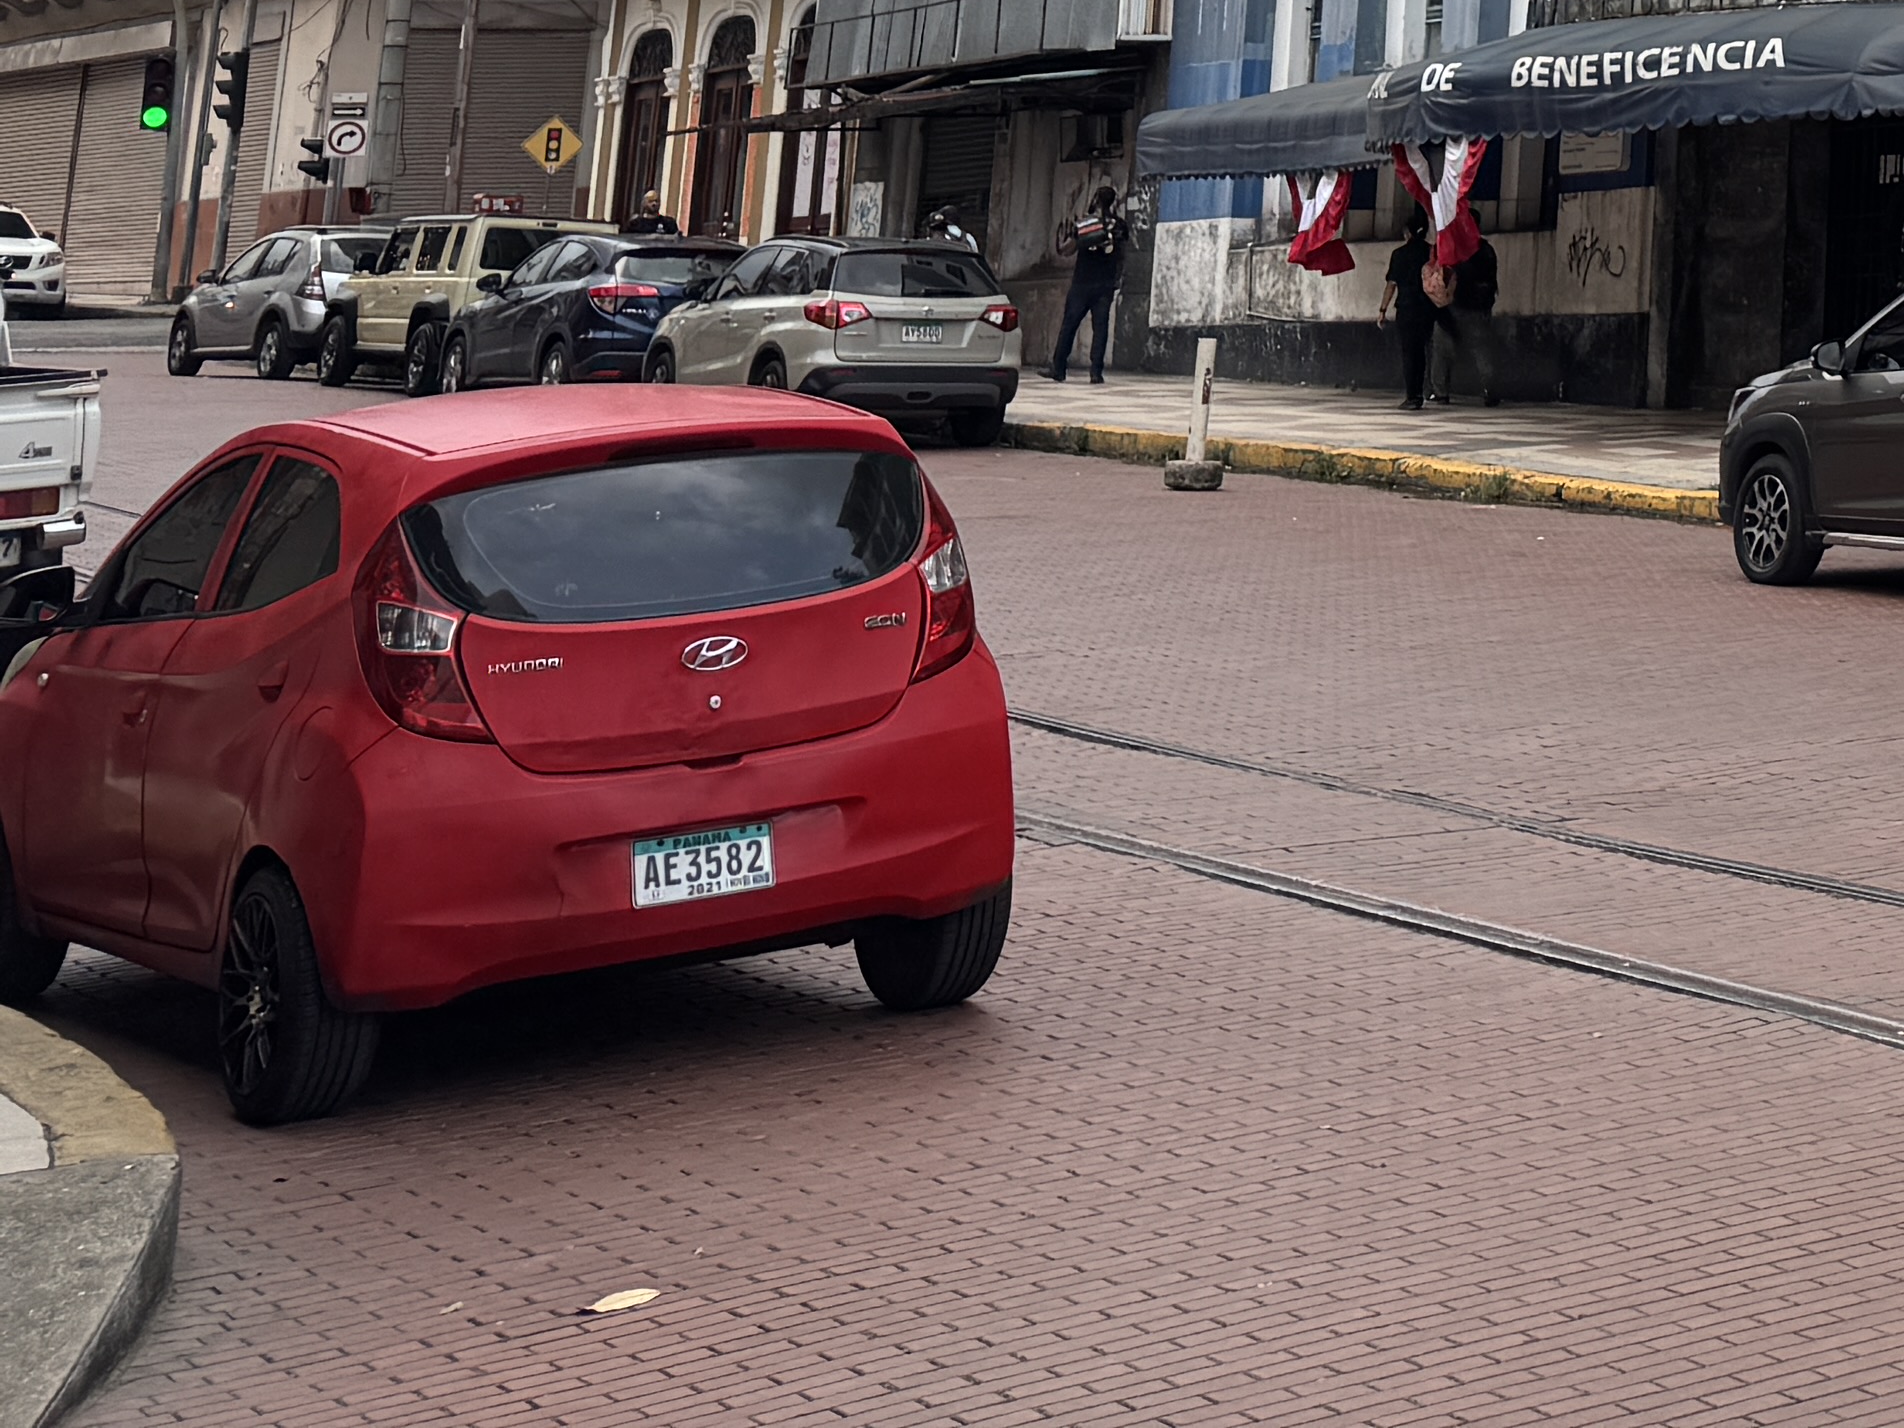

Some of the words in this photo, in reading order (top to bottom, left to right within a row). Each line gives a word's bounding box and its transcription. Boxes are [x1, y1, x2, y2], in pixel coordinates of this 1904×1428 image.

[1420, 62, 1462, 92] DE
[1510, 37, 1787, 88] BENEFICENCIA
[488, 657, 564, 675] HYUNDAI
[673, 831, 732, 849] PANAMA
[644, 840, 764, 890] AE3582
[687, 881, 722, 896] 2021
